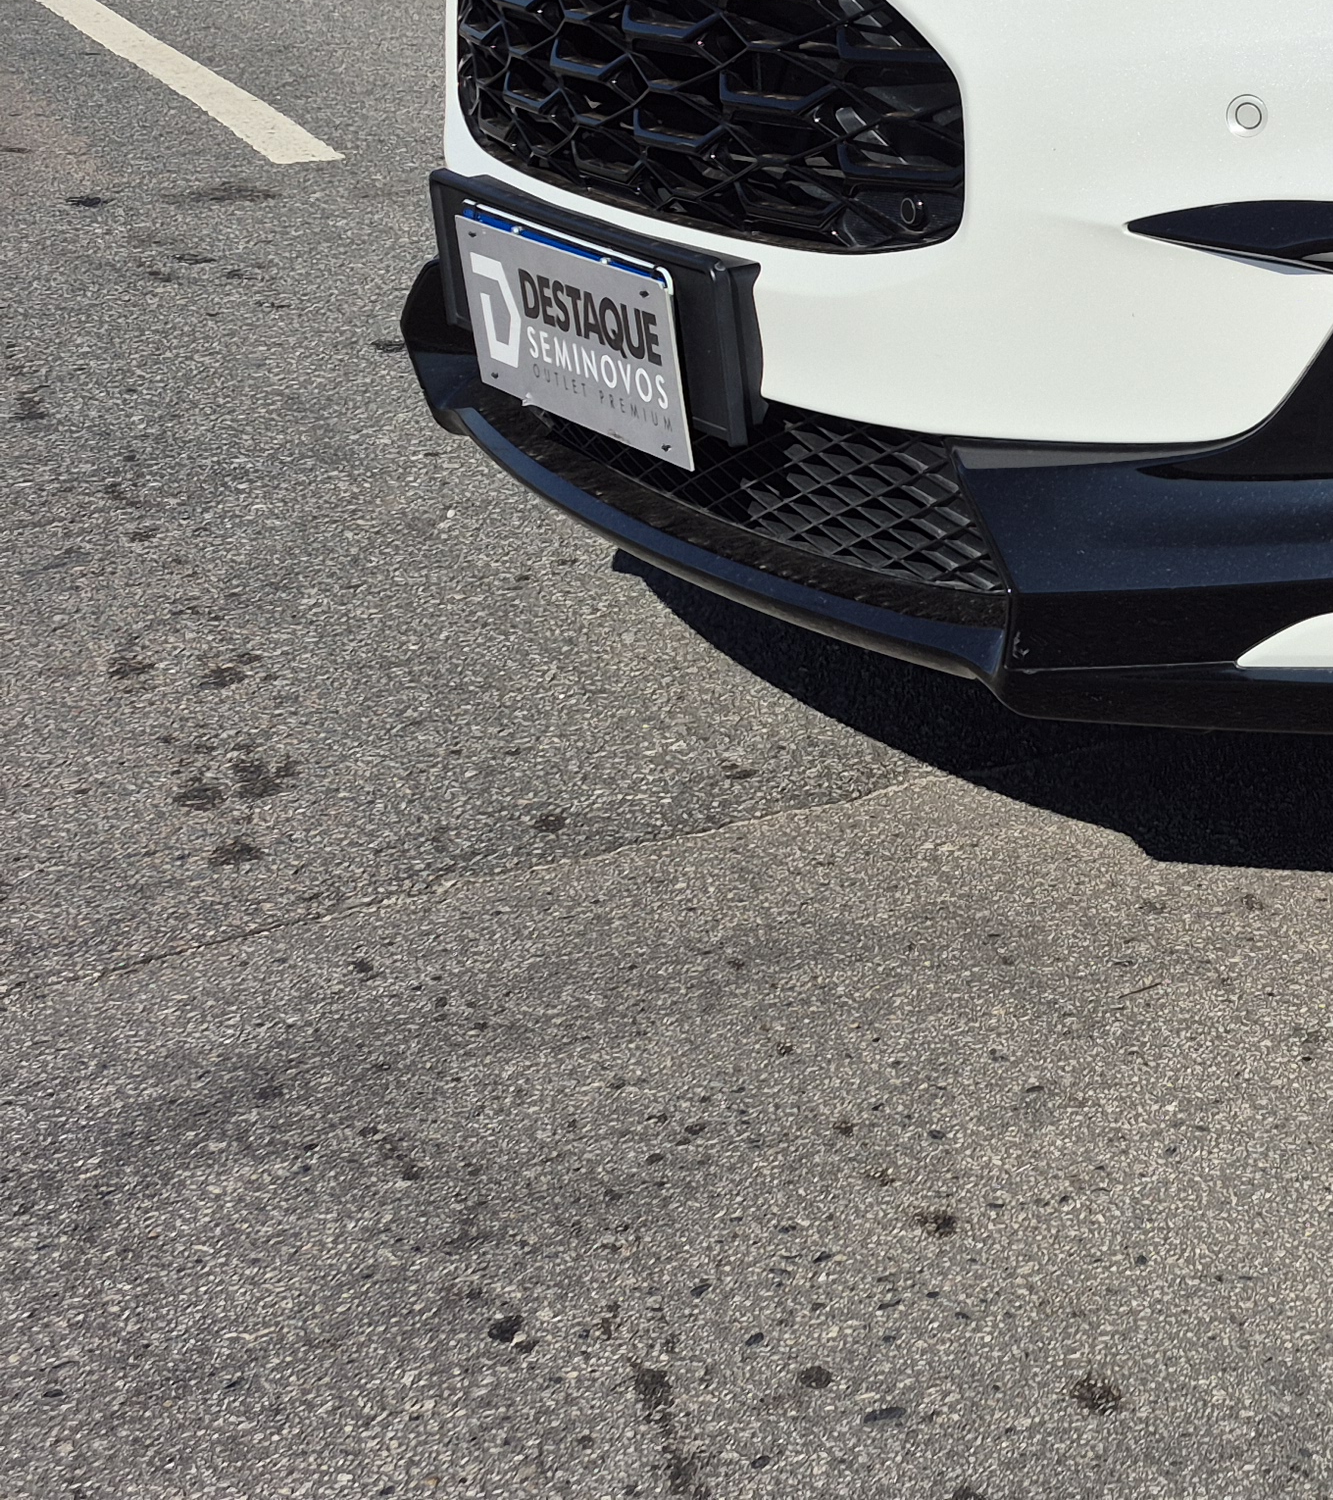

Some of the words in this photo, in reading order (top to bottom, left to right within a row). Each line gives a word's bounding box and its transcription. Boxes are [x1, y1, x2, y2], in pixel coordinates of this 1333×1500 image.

[518, 267, 663, 367] DESTAQUE
[526, 325, 669, 410] SEMINOVOS
[532, 362, 587, 398] OUTLET
[599, 390, 674, 434] PREMIUM
